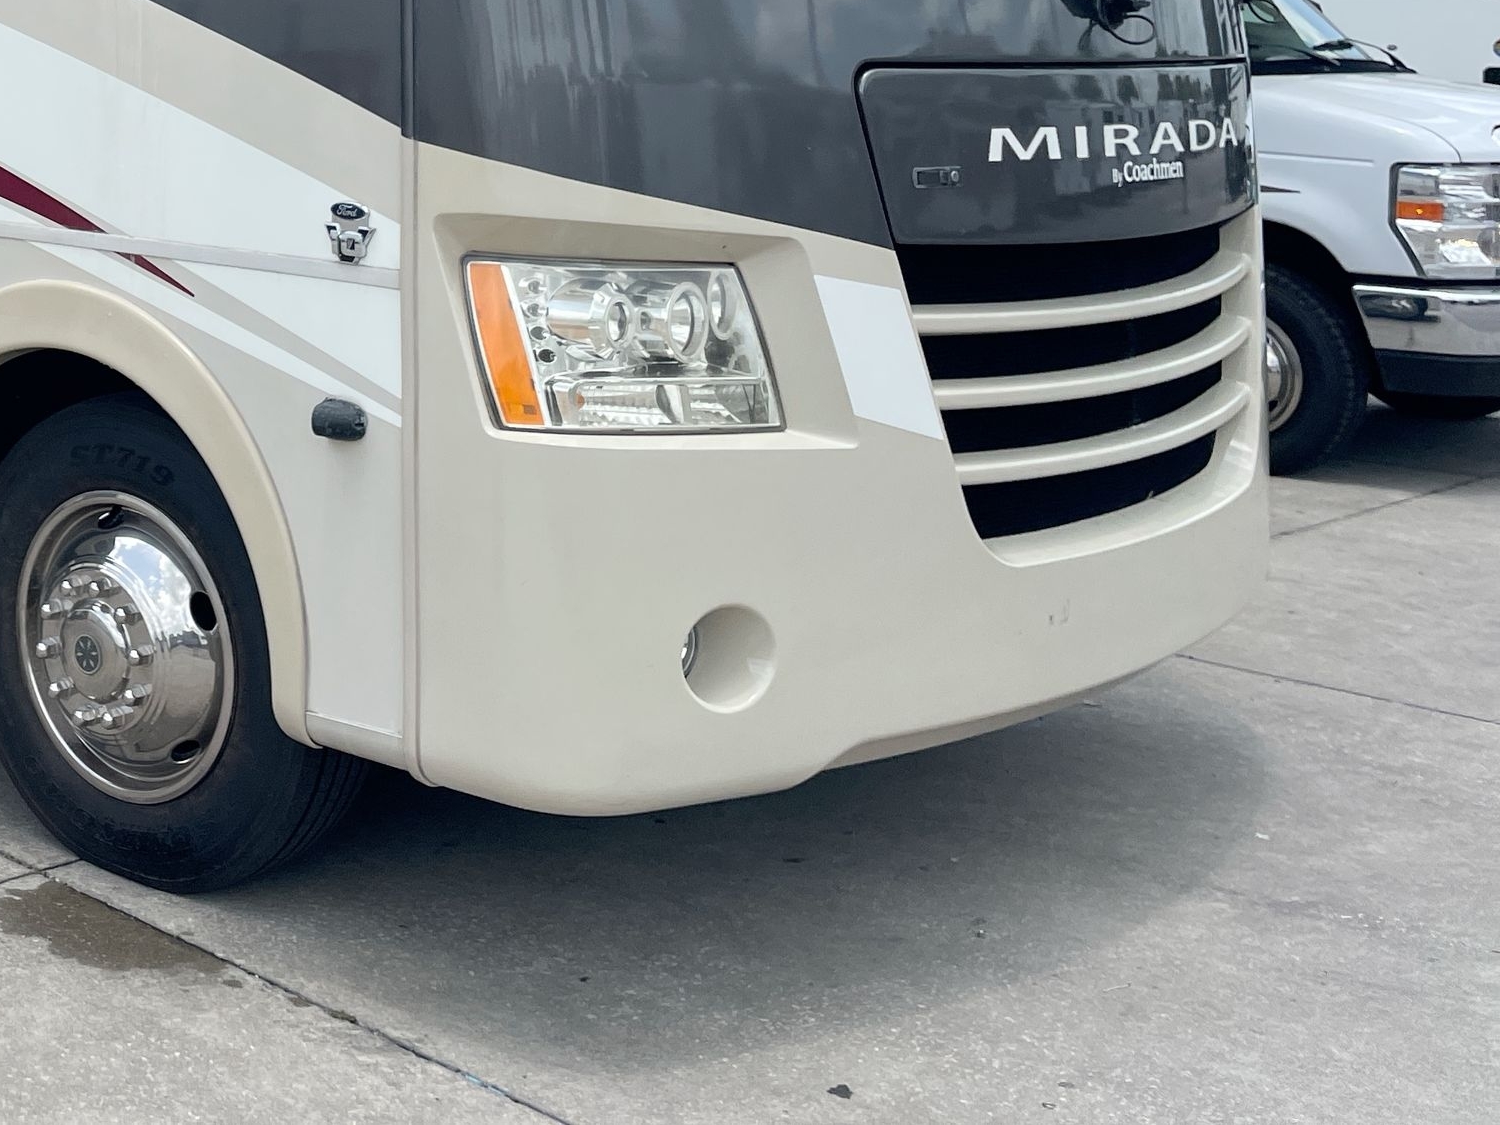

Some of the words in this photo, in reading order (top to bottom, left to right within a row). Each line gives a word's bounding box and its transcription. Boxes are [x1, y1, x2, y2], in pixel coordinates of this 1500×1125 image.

[988, 117, 1239, 163] MIRADA
[1123, 159, 1185, 183] Coachmen
[336, 204, 358, 217] Ford
